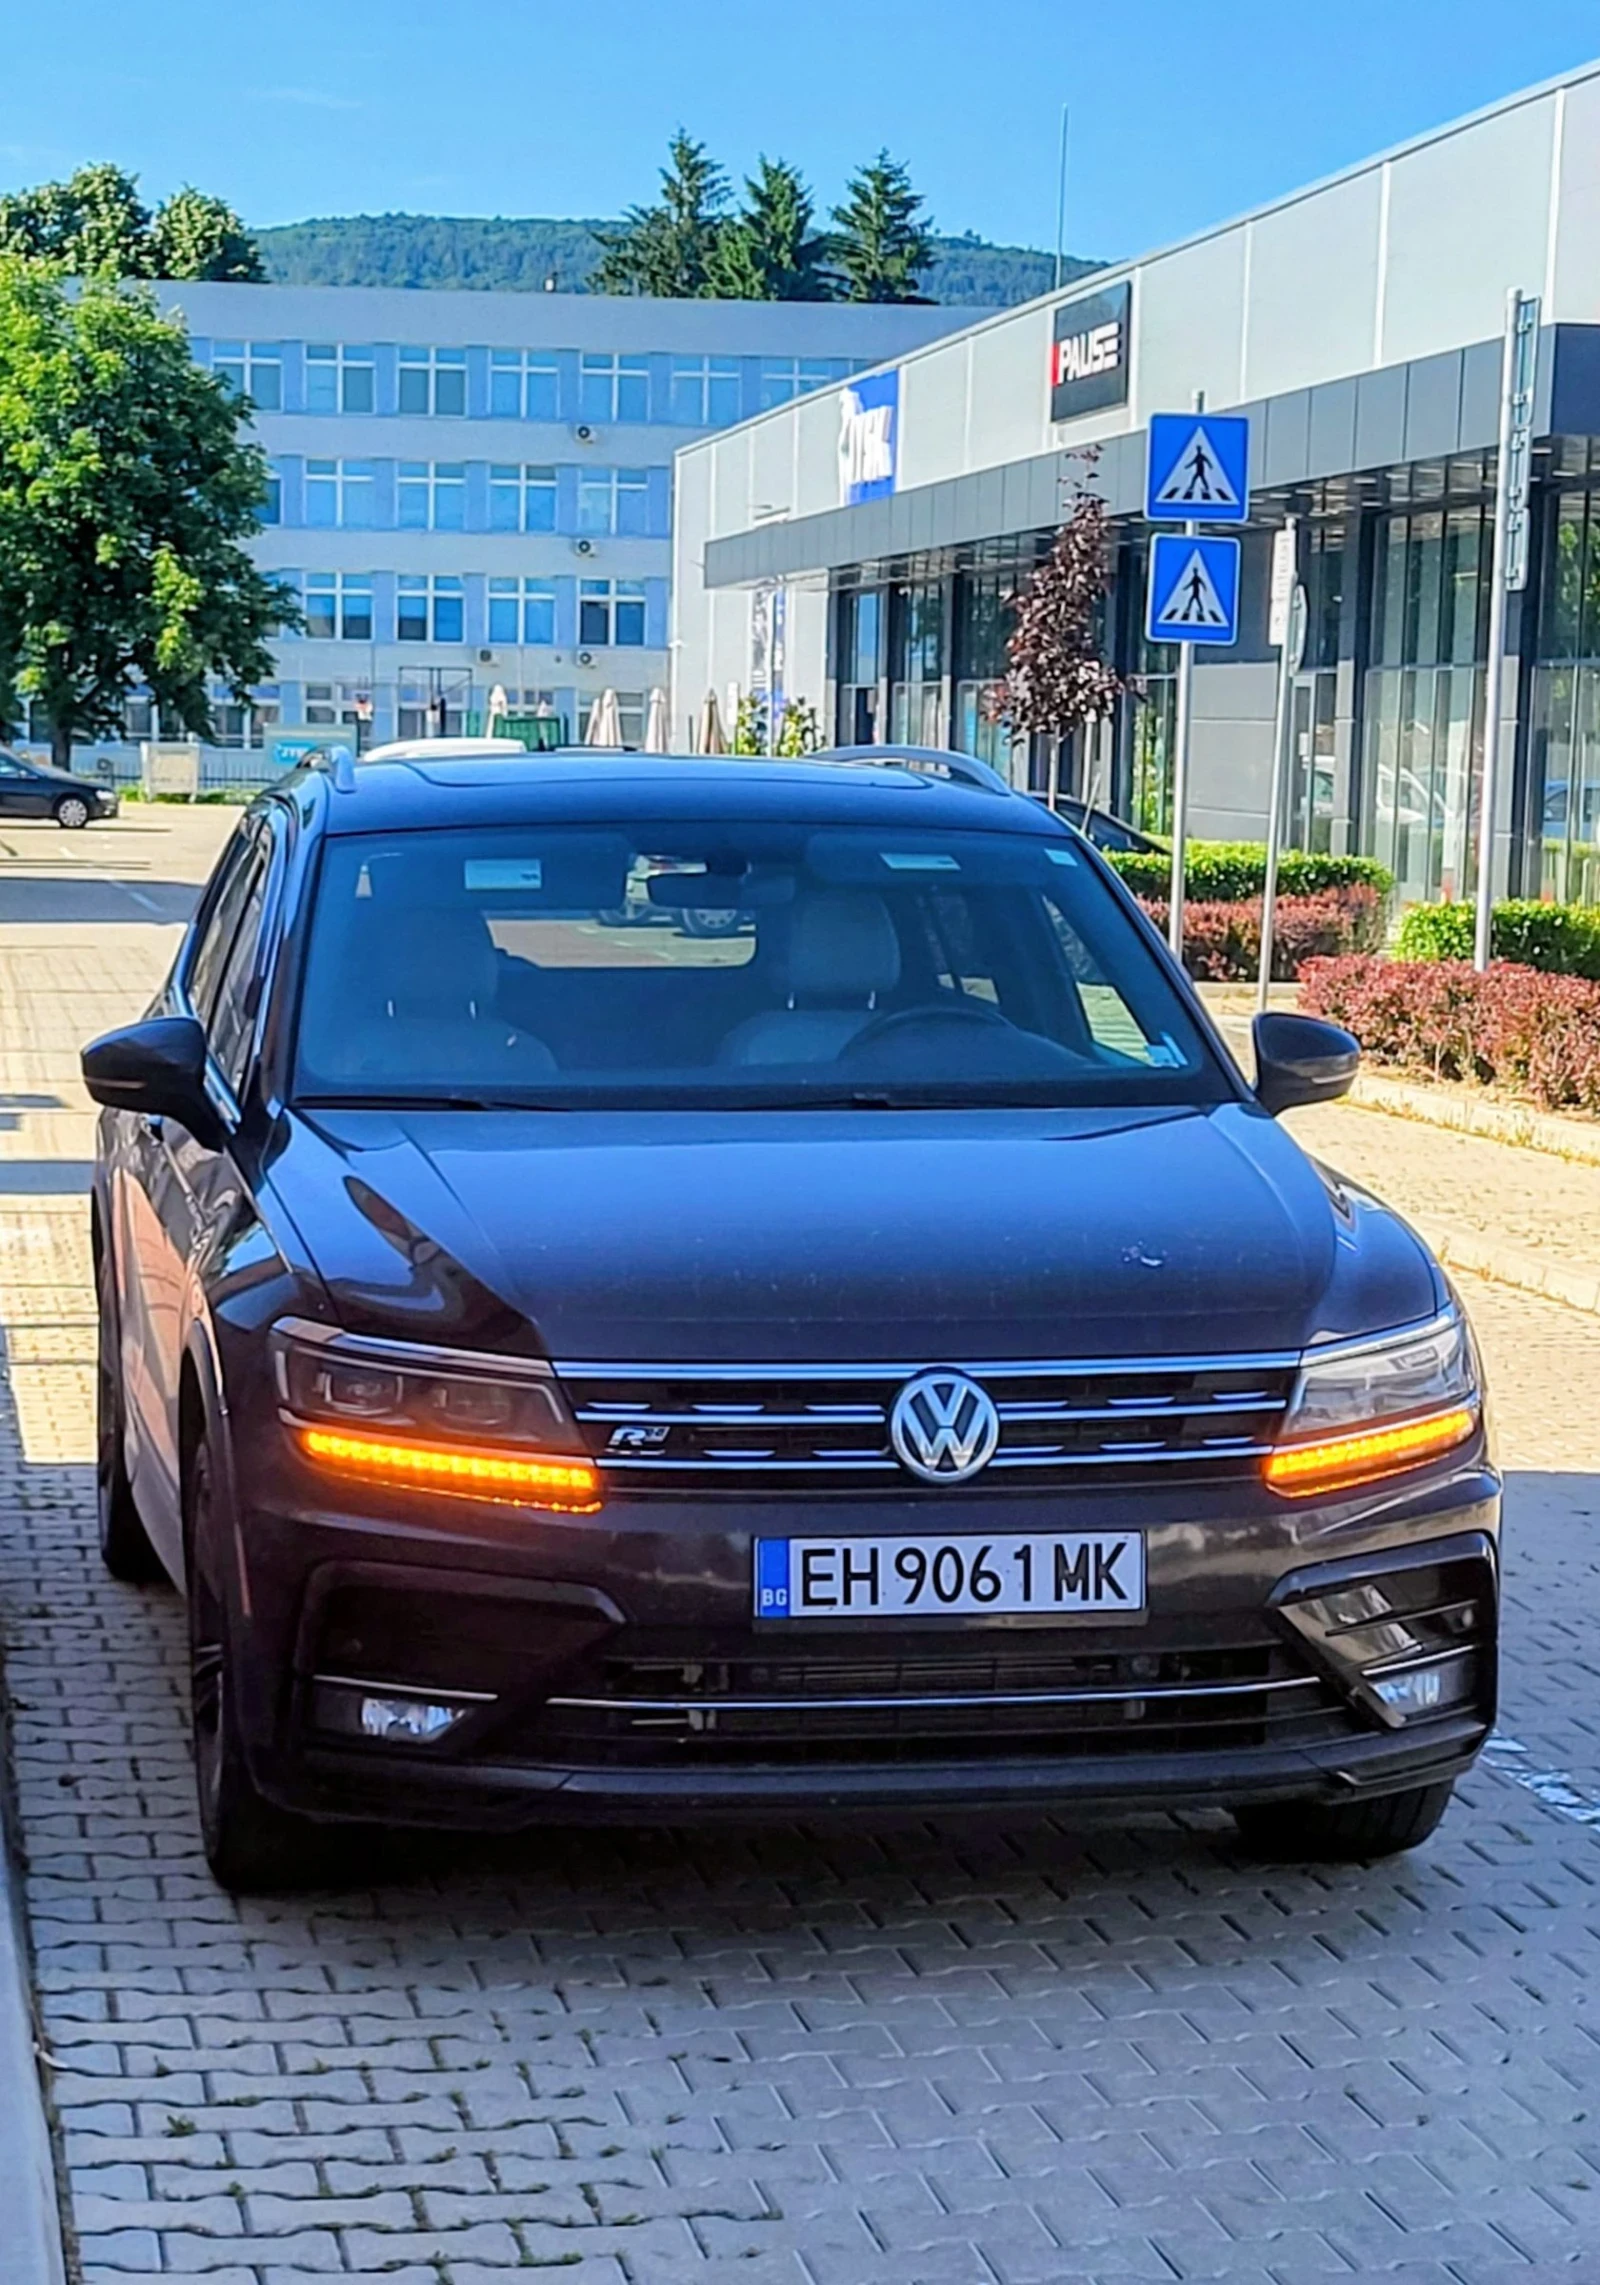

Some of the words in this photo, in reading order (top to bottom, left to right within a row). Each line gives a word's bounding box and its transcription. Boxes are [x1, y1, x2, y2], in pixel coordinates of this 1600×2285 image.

[1059, 321, 1119, 384] PAUSE
[761, 1588, 788, 1606] BG
[802, 1547, 879, 1606] EH
[894, 1544, 1032, 1604] 9061
[1054, 1542, 1128, 1602] MK
